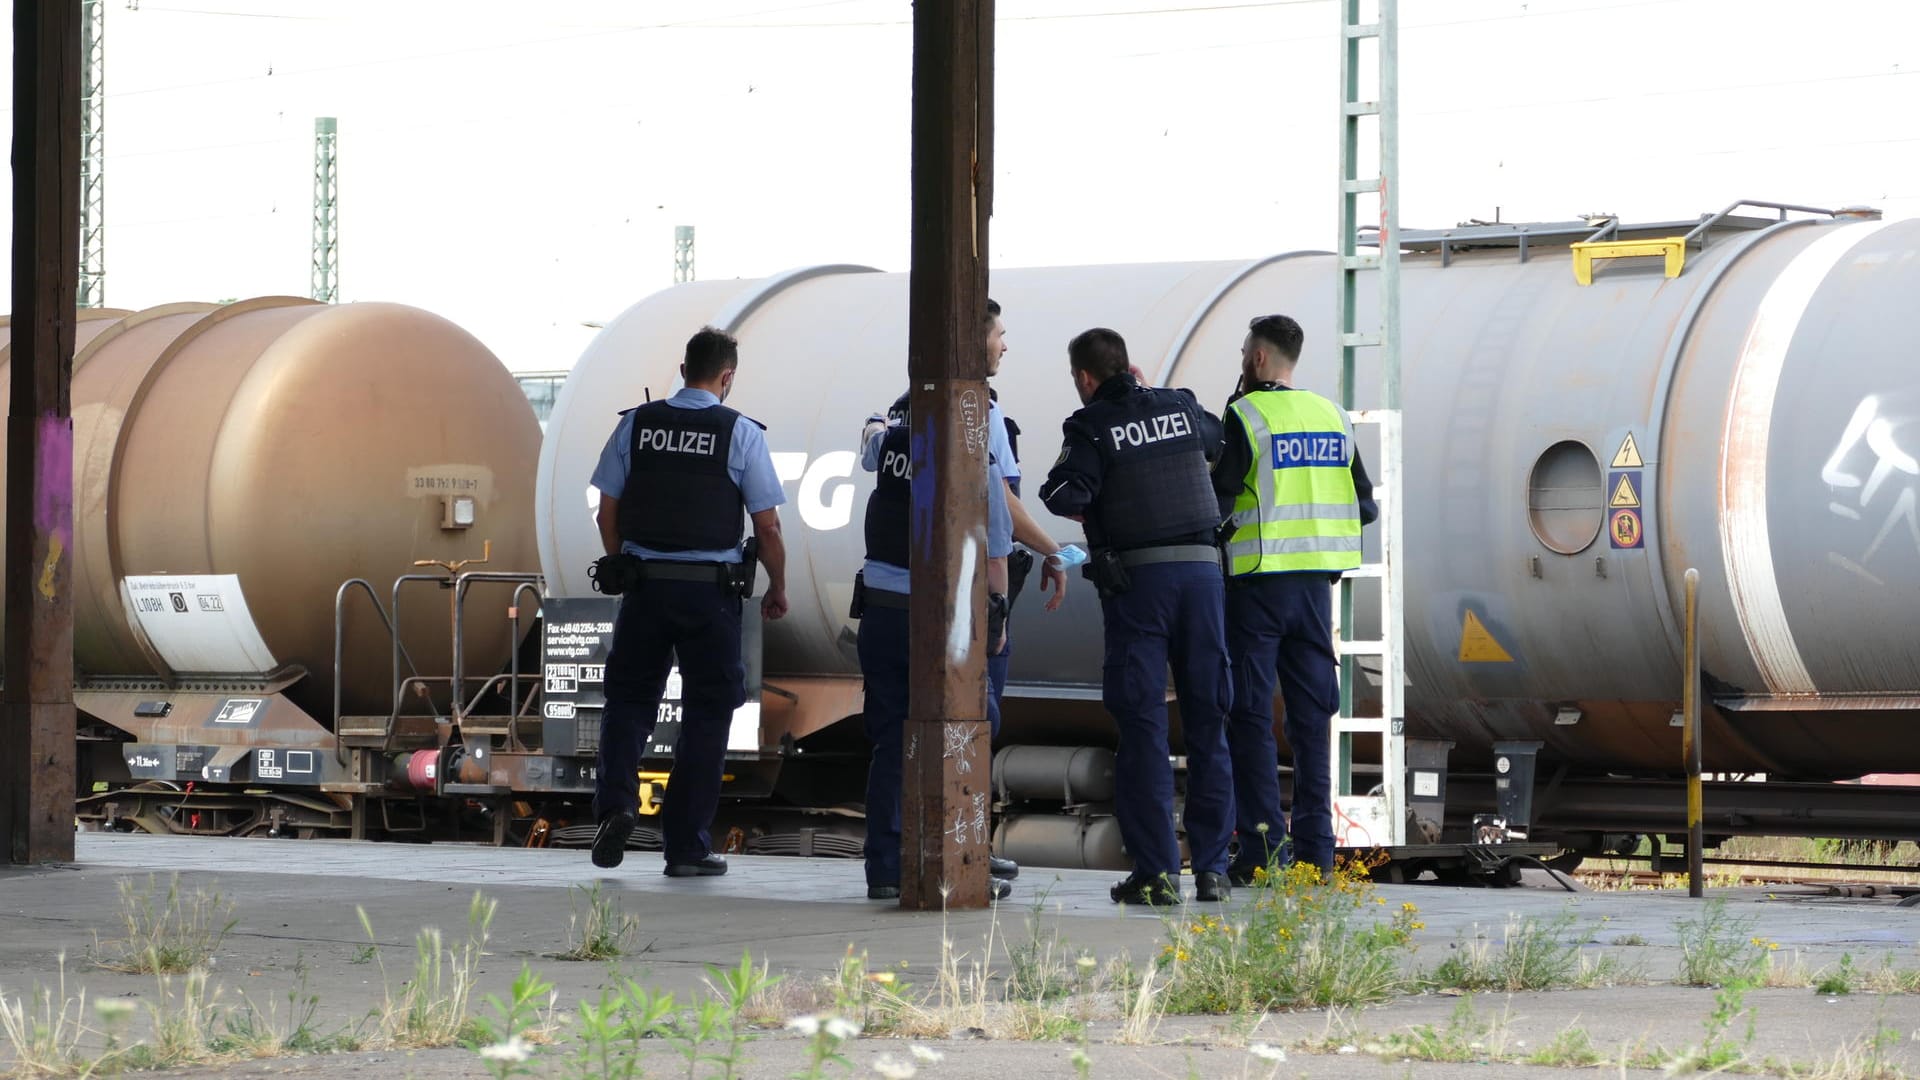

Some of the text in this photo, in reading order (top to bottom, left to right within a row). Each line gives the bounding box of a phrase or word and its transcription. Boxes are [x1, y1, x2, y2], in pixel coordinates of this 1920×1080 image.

[639, 428, 716, 456] POLIZEI
[1110, 412, 1192, 450] POLIZEI
[1277, 438, 1347, 463] POLIZEI
[882, 450, 912, 480] POL
[547, 623, 560, 634] Fax
[547, 634, 600, 646] service@vtg.com
[547, 646, 590, 658] www.vtg.com
